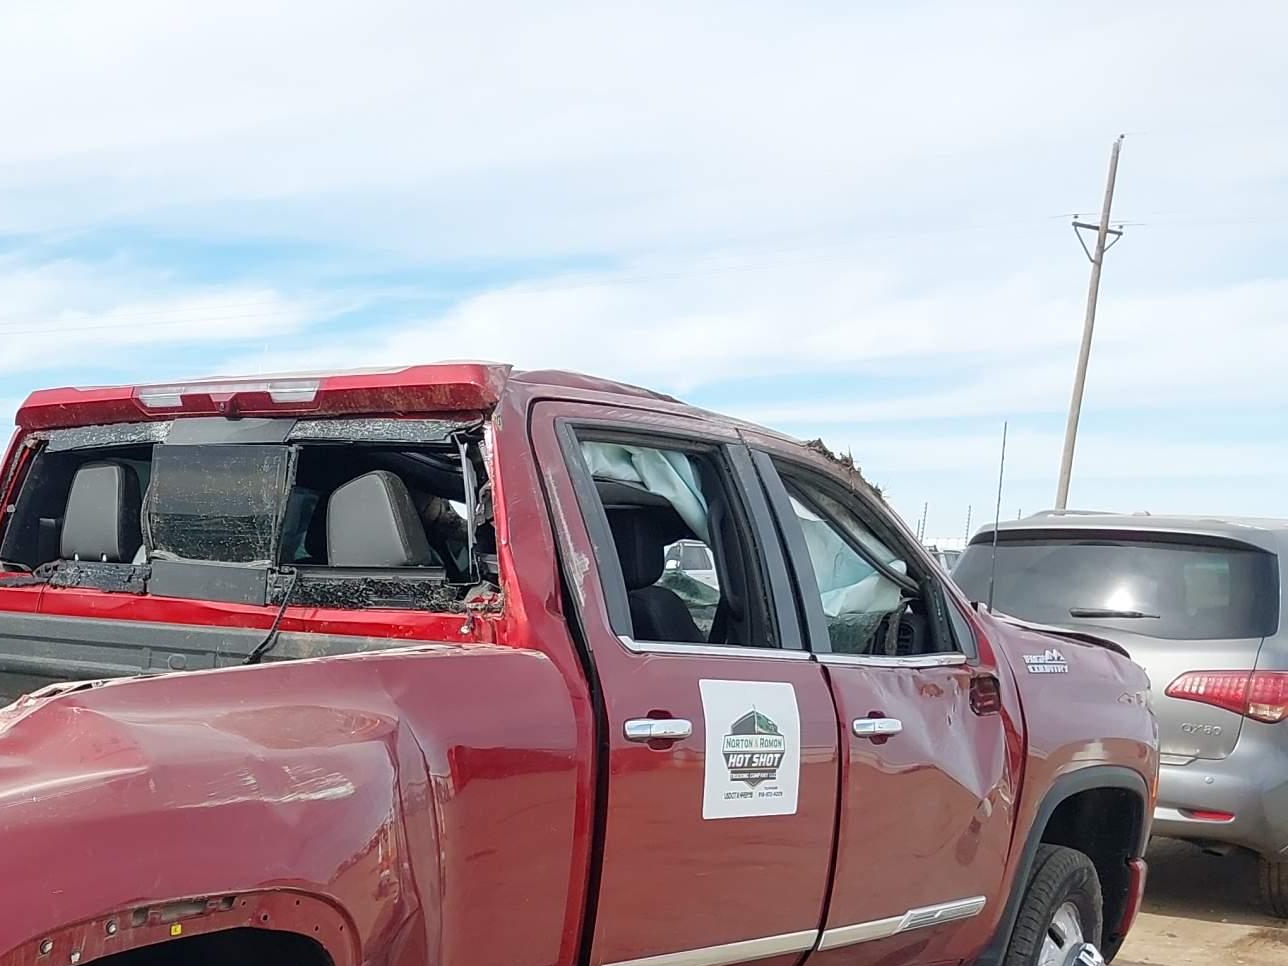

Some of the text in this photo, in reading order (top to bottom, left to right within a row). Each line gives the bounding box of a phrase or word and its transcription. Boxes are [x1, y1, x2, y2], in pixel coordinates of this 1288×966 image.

[725, 737, 753, 749] NORTON
[728, 753, 781, 767] HOT SHOT
